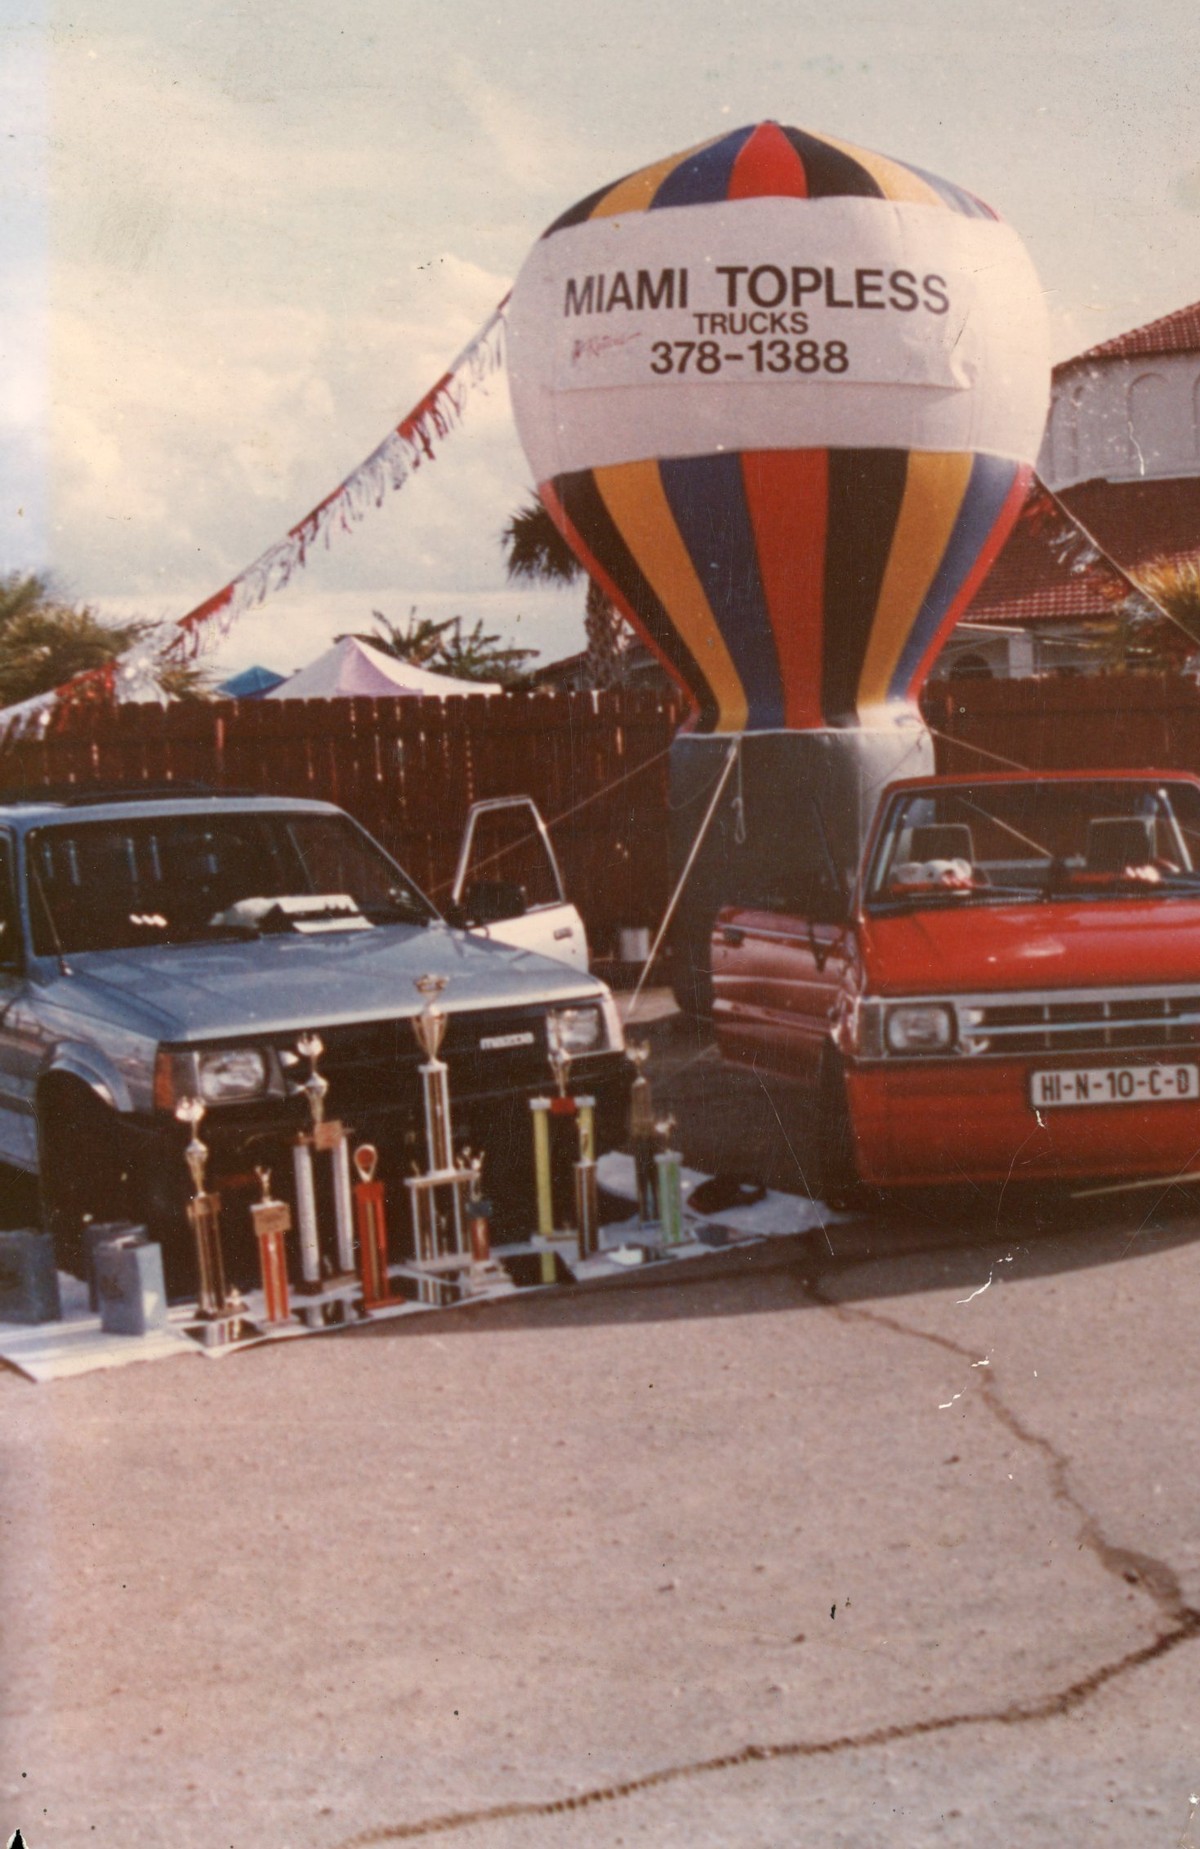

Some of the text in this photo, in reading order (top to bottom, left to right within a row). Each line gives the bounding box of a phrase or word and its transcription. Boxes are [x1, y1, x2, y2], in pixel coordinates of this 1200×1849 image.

[564, 265, 950, 317] MIAMI TOPLESS
[693, 311, 809, 335] TRUCKS
[650, 340, 849, 375] 378-1388
[1040, 1068, 1190, 1101] HI-N-10-C-D
